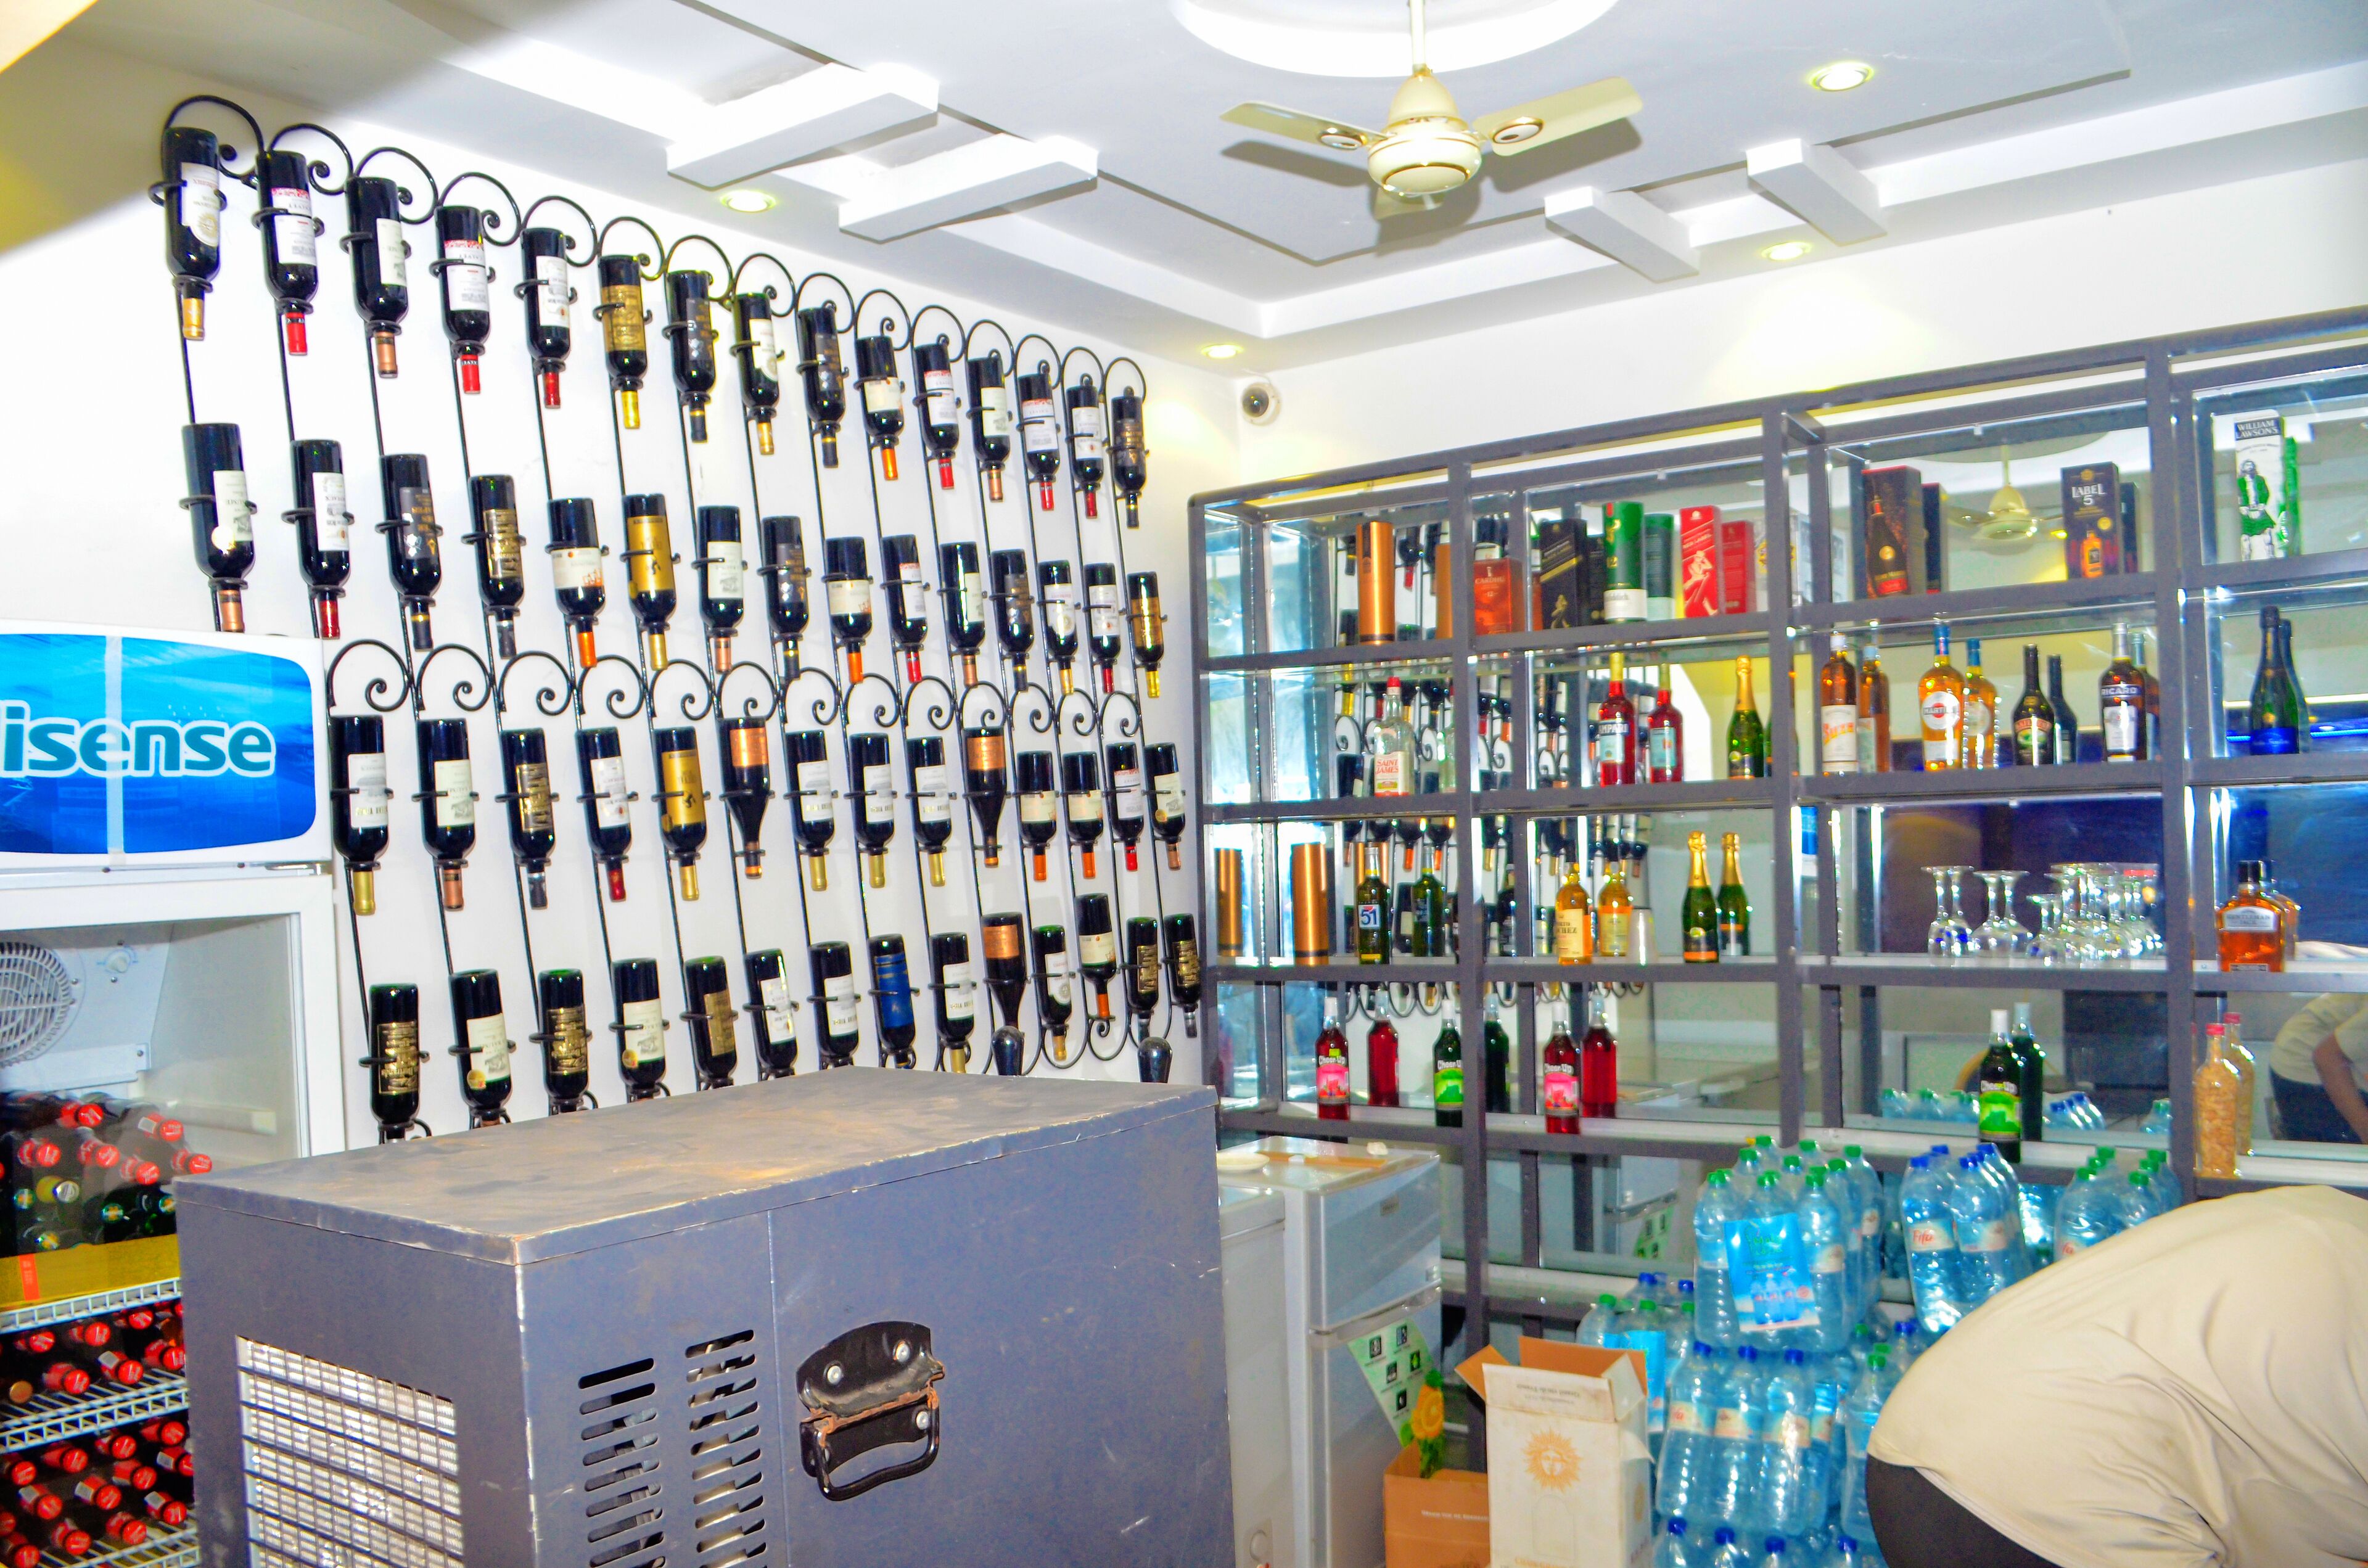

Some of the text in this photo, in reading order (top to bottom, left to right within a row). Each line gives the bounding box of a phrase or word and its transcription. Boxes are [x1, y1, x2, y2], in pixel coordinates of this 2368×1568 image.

[2237, 419, 2275, 431] WILLIAM
[2072, 483, 2107, 498] LABEL
[2082, 495, 2094, 505] 5
[2101, 687, 2137, 696] RICARD
[0, 700, 276, 778] isense
[1375, 766, 1399, 775] JAMES
[1360, 909, 1378, 925] 51
[1318, 1055, 1346, 1066] Cheer-Up
[1437, 1059, 1462, 1070] Cheer-U
